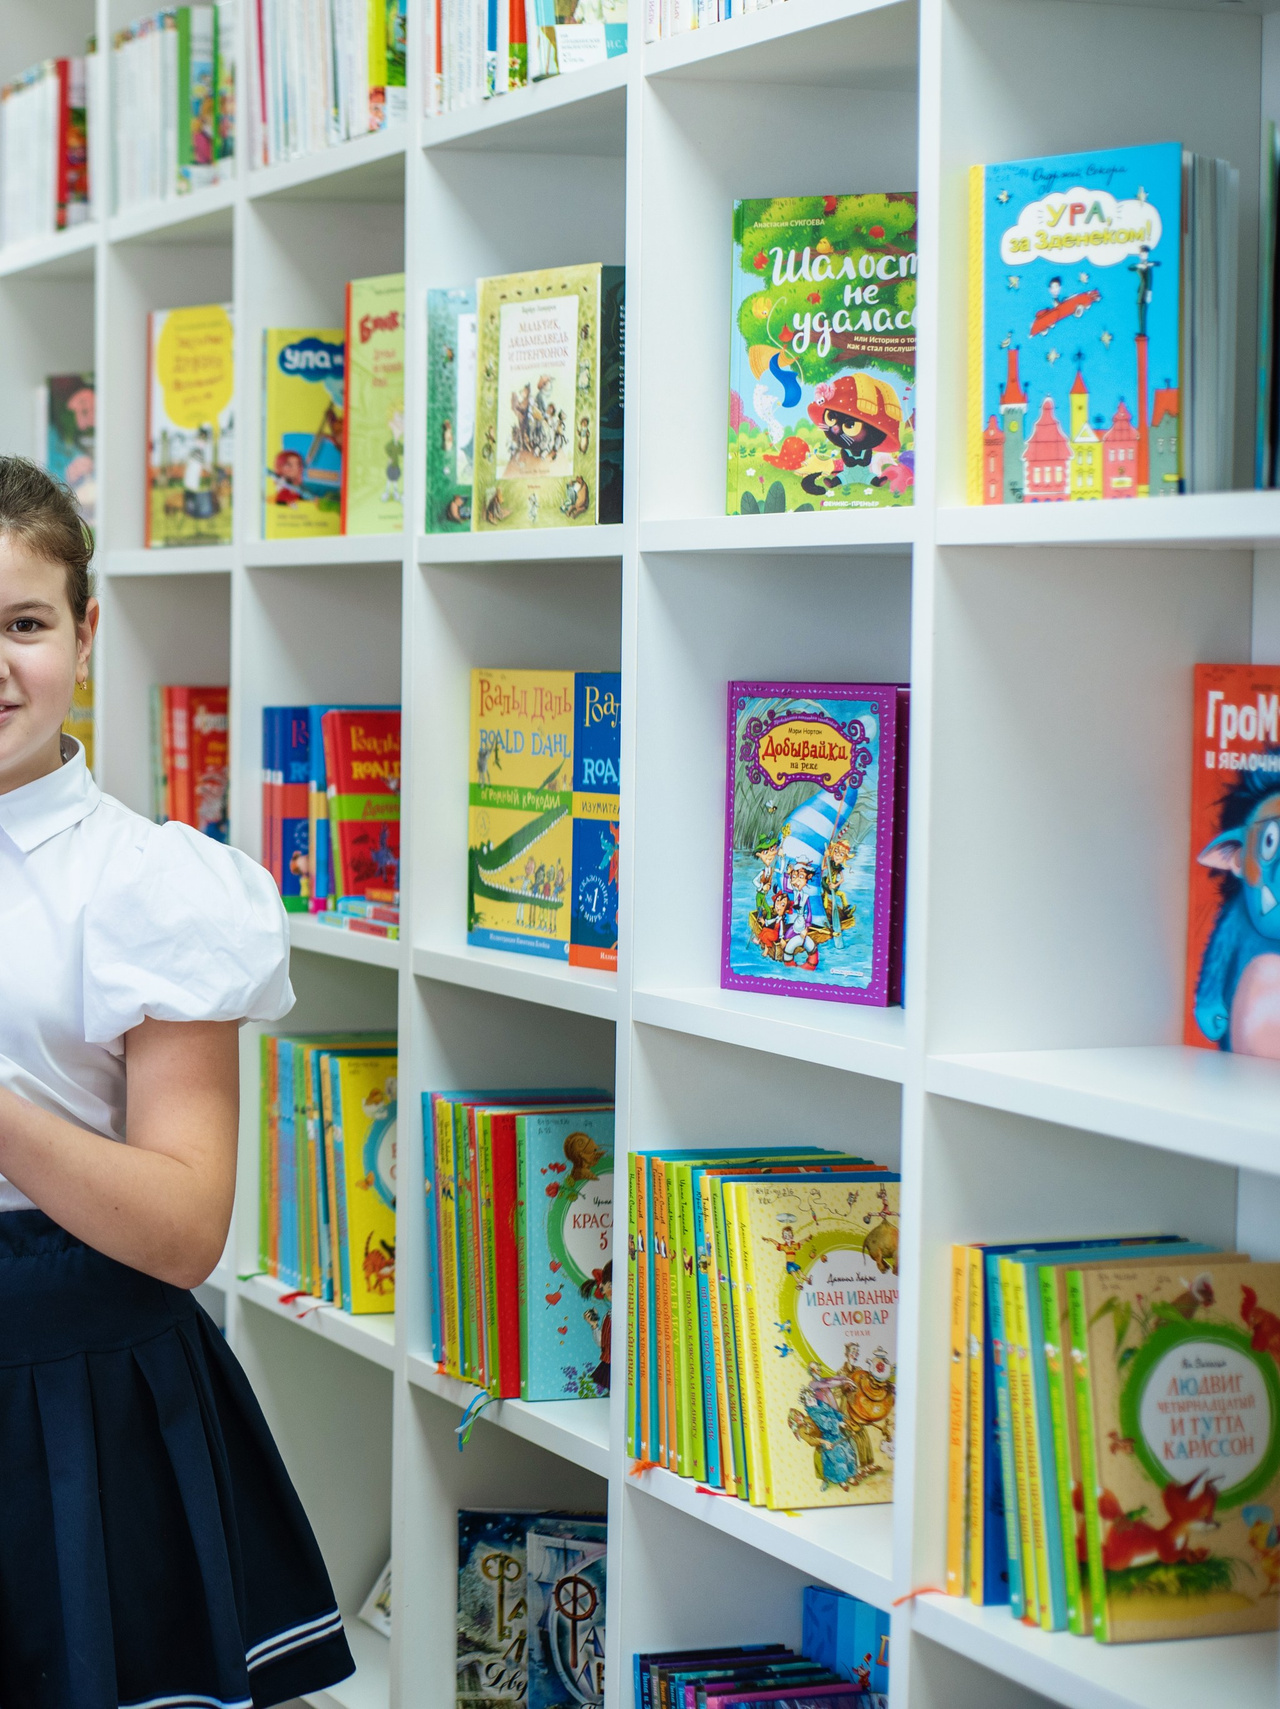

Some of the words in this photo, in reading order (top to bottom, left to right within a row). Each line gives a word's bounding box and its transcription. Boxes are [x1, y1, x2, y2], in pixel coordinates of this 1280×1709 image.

[753, 220, 789, 229] Анастасия
[1046, 200, 1113, 227] УРА,
[1009, 236, 1030, 253] за
[1035, 219, 1152, 251] Зденеком!
[843, 284, 880, 307] не
[846, 343, 859, 351] как
[867, 344, 883, 352] стал
[854, 335, 868, 343] или
[869, 335, 900, 345] История
[478, 678, 528, 718] Роальд
[531, 686, 572, 723] Даль
[788, 727, 802, 736] Мэри
[803, 728, 822, 736] Нортон
[1206, 690, 1280, 749] ГроМ
[479, 728, 525, 754] ROALD
[531, 732, 571, 758] DAHL
[762, 735, 848, 762] Добывайки
[582, 757, 620, 786] ROA
[790, 761, 799, 769] на
[801, 761, 818, 771] реке
[1219, 751, 1280, 773] ЯБЛОЧН
[599, 1230, 608, 1251] 5
[826, 1273, 854, 1286] Даниил
[856, 1272, 876, 1284] Хармс
[655, 1268, 663, 1335] БЕСПОКОЙНЫЙ
[663, 1272, 671, 1341] БЕСПОКОЙНЫЙ
[671, 1301, 678, 1310] В
[709, 1278, 718, 1332] ЗОЛОТОЕ
[806, 1291, 844, 1307] ИВАН
[846, 1289, 898, 1306] ИВАНЫЧ
[672, 1313, 680, 1346] ЛЕСУ
[702, 1311, 709, 1328] ПО
[733, 1304, 741, 1333] ИВАН
[748, 1307, 757, 1337] ИВАН
[822, 1309, 889, 1327] САМОВАР
[721, 1303, 732, 1363] РАССКАЗЫ
[845, 1329, 871, 1337] СТИХИ
[687, 1335, 696, 1381] КЛЯКСИЧА
[703, 1329, 711, 1373] ГОРОДУ
[713, 1332, 723, 1384] ДЕТСТВО
[751, 1338, 761, 1380] ИВАНЫЧ
[727, 1364, 734, 1373] И
[690, 1382, 696, 1391] И
[728, 1376, 738, 1422] СКАЗКИ
[1167, 1374, 1243, 1396] ЛЮДВИГ
[705, 1375, 715, 1441] ВОЛШЕБНИК
[756, 1381, 765, 1433] САМОВАР
[951, 1383, 963, 1447] ДРУЗЬЯ
[1157, 1393, 1255, 1414] ЧЕТЫРНАДЦАТЫЙ
[1010, 1369, 1025, 1472] ПРИКЛЮЧЕНИЯ
[1021, 1374, 1037, 1478] ПРИКЛЮЧЕНИЯ
[1170, 1417, 1185, 1436] И
[1190, 1414, 1245, 1438] ТУТТА
[1163, 1436, 1255, 1461] КАРЛССОН
